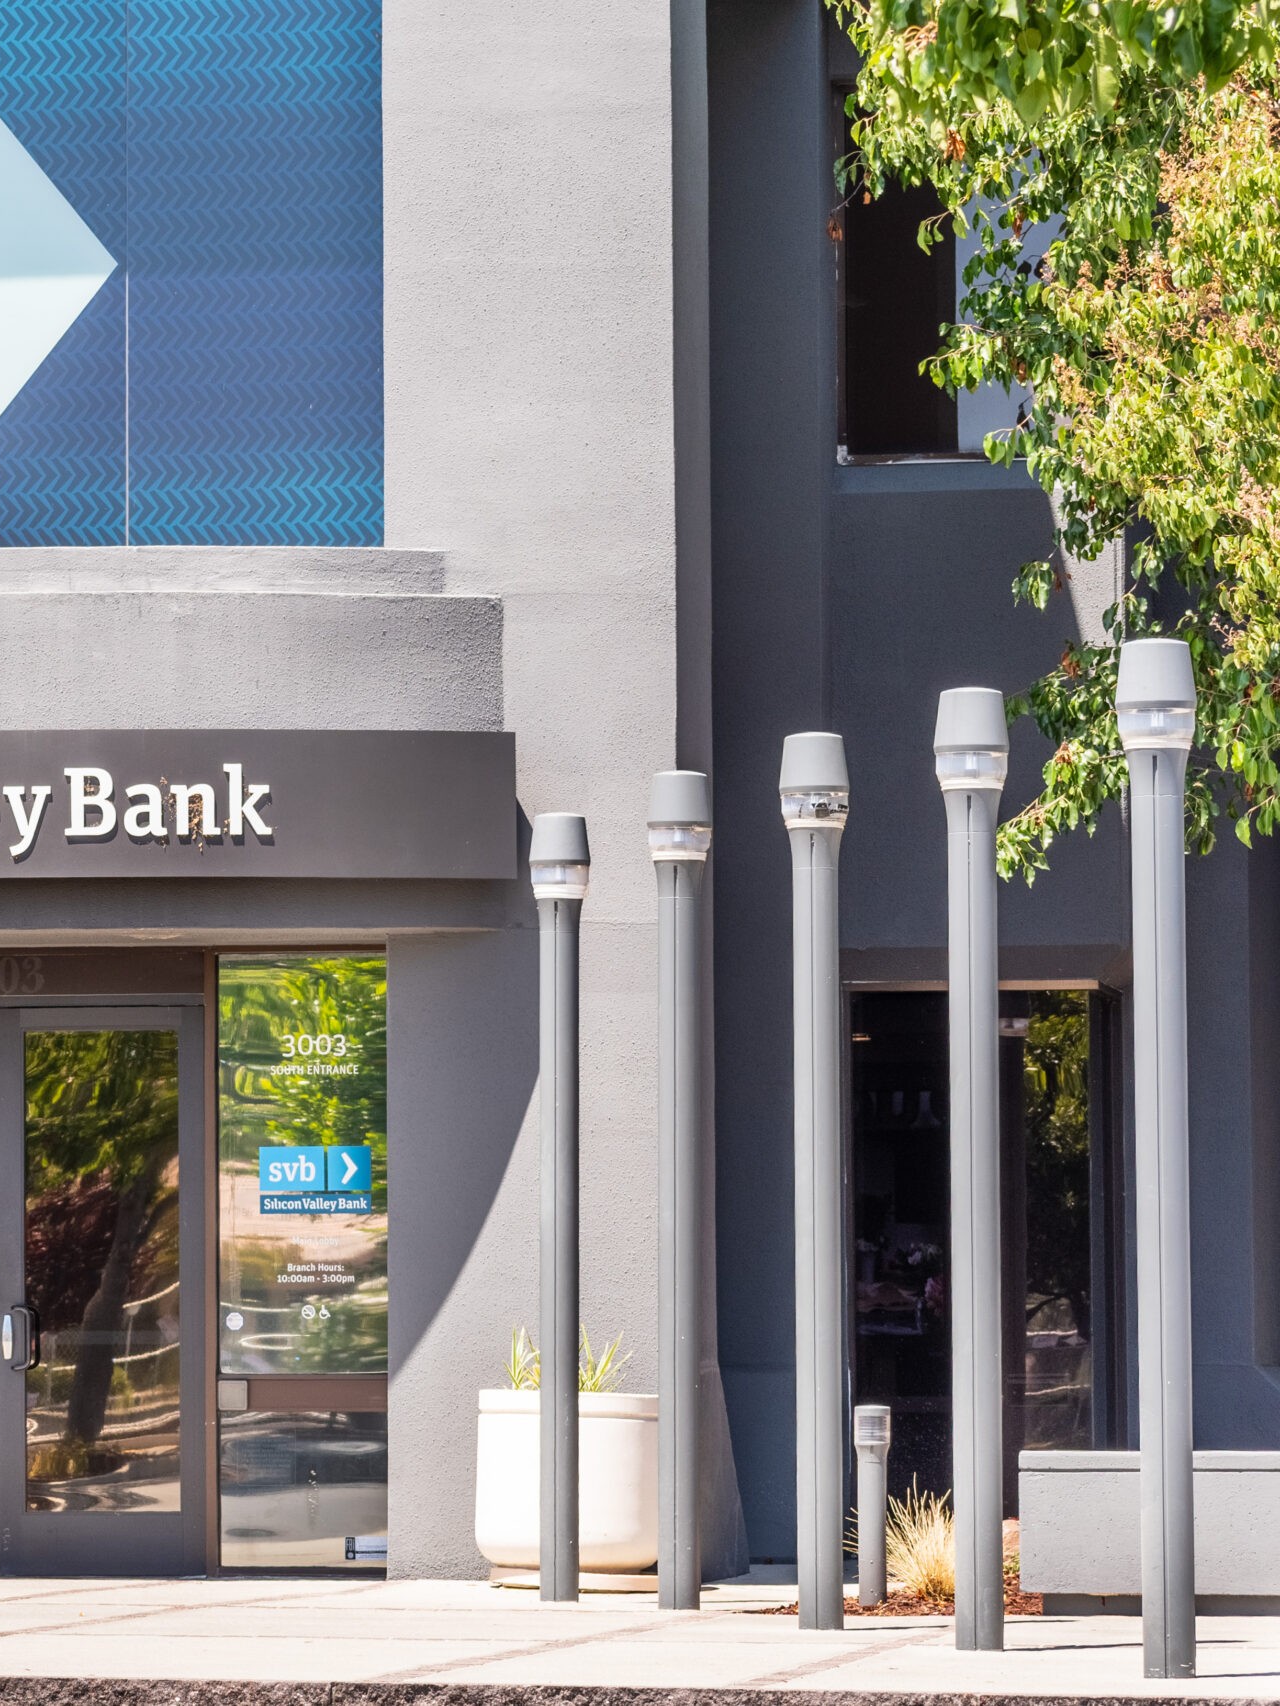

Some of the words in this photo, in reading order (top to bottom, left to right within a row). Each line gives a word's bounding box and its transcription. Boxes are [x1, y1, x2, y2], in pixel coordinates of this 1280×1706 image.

[63, 762, 274, 838] Bank
[281, 1033, 347, 1058] 3003
[269, 1064, 305, 1076] SOUTH
[307, 1064, 360, 1076] ENTRANCE
[268, 1154, 317, 1183] svb
[301, 1198, 337, 1213] Valley
[337, 1197, 368, 1210] Bank
[287, 1262, 316, 1272] Branch
[317, 1262, 345, 1272] Hours:
[276, 1274, 316, 1284] 10:00am
[321, 1274, 356, 1285] 3:00pm
